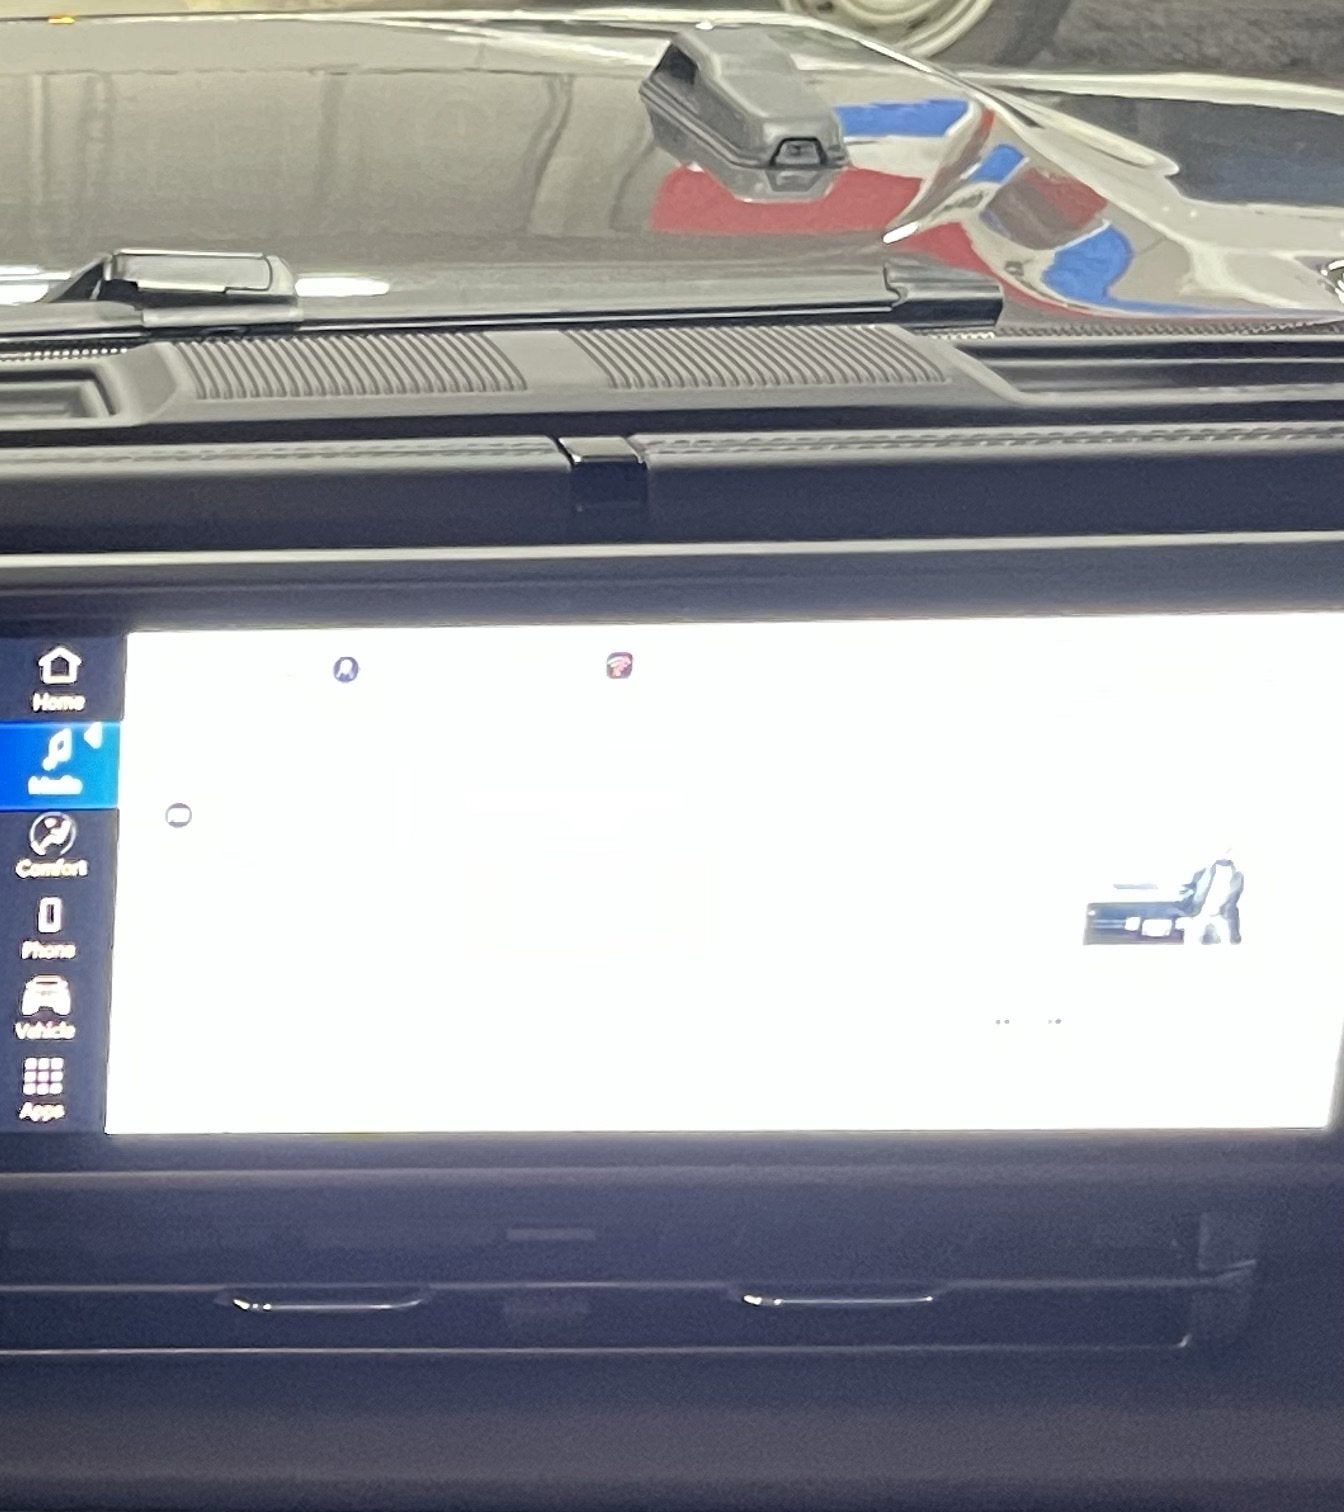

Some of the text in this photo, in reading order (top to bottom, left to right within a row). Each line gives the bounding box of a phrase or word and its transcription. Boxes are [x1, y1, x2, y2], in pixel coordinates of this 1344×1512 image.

[32, 692, 86, 713] Home
[15, 859, 88, 879] Comfort
[21, 941, 76, 961] Phone
[15, 1021, 76, 1041] Vehicle
[18, 1103, 65, 1123] Apps
